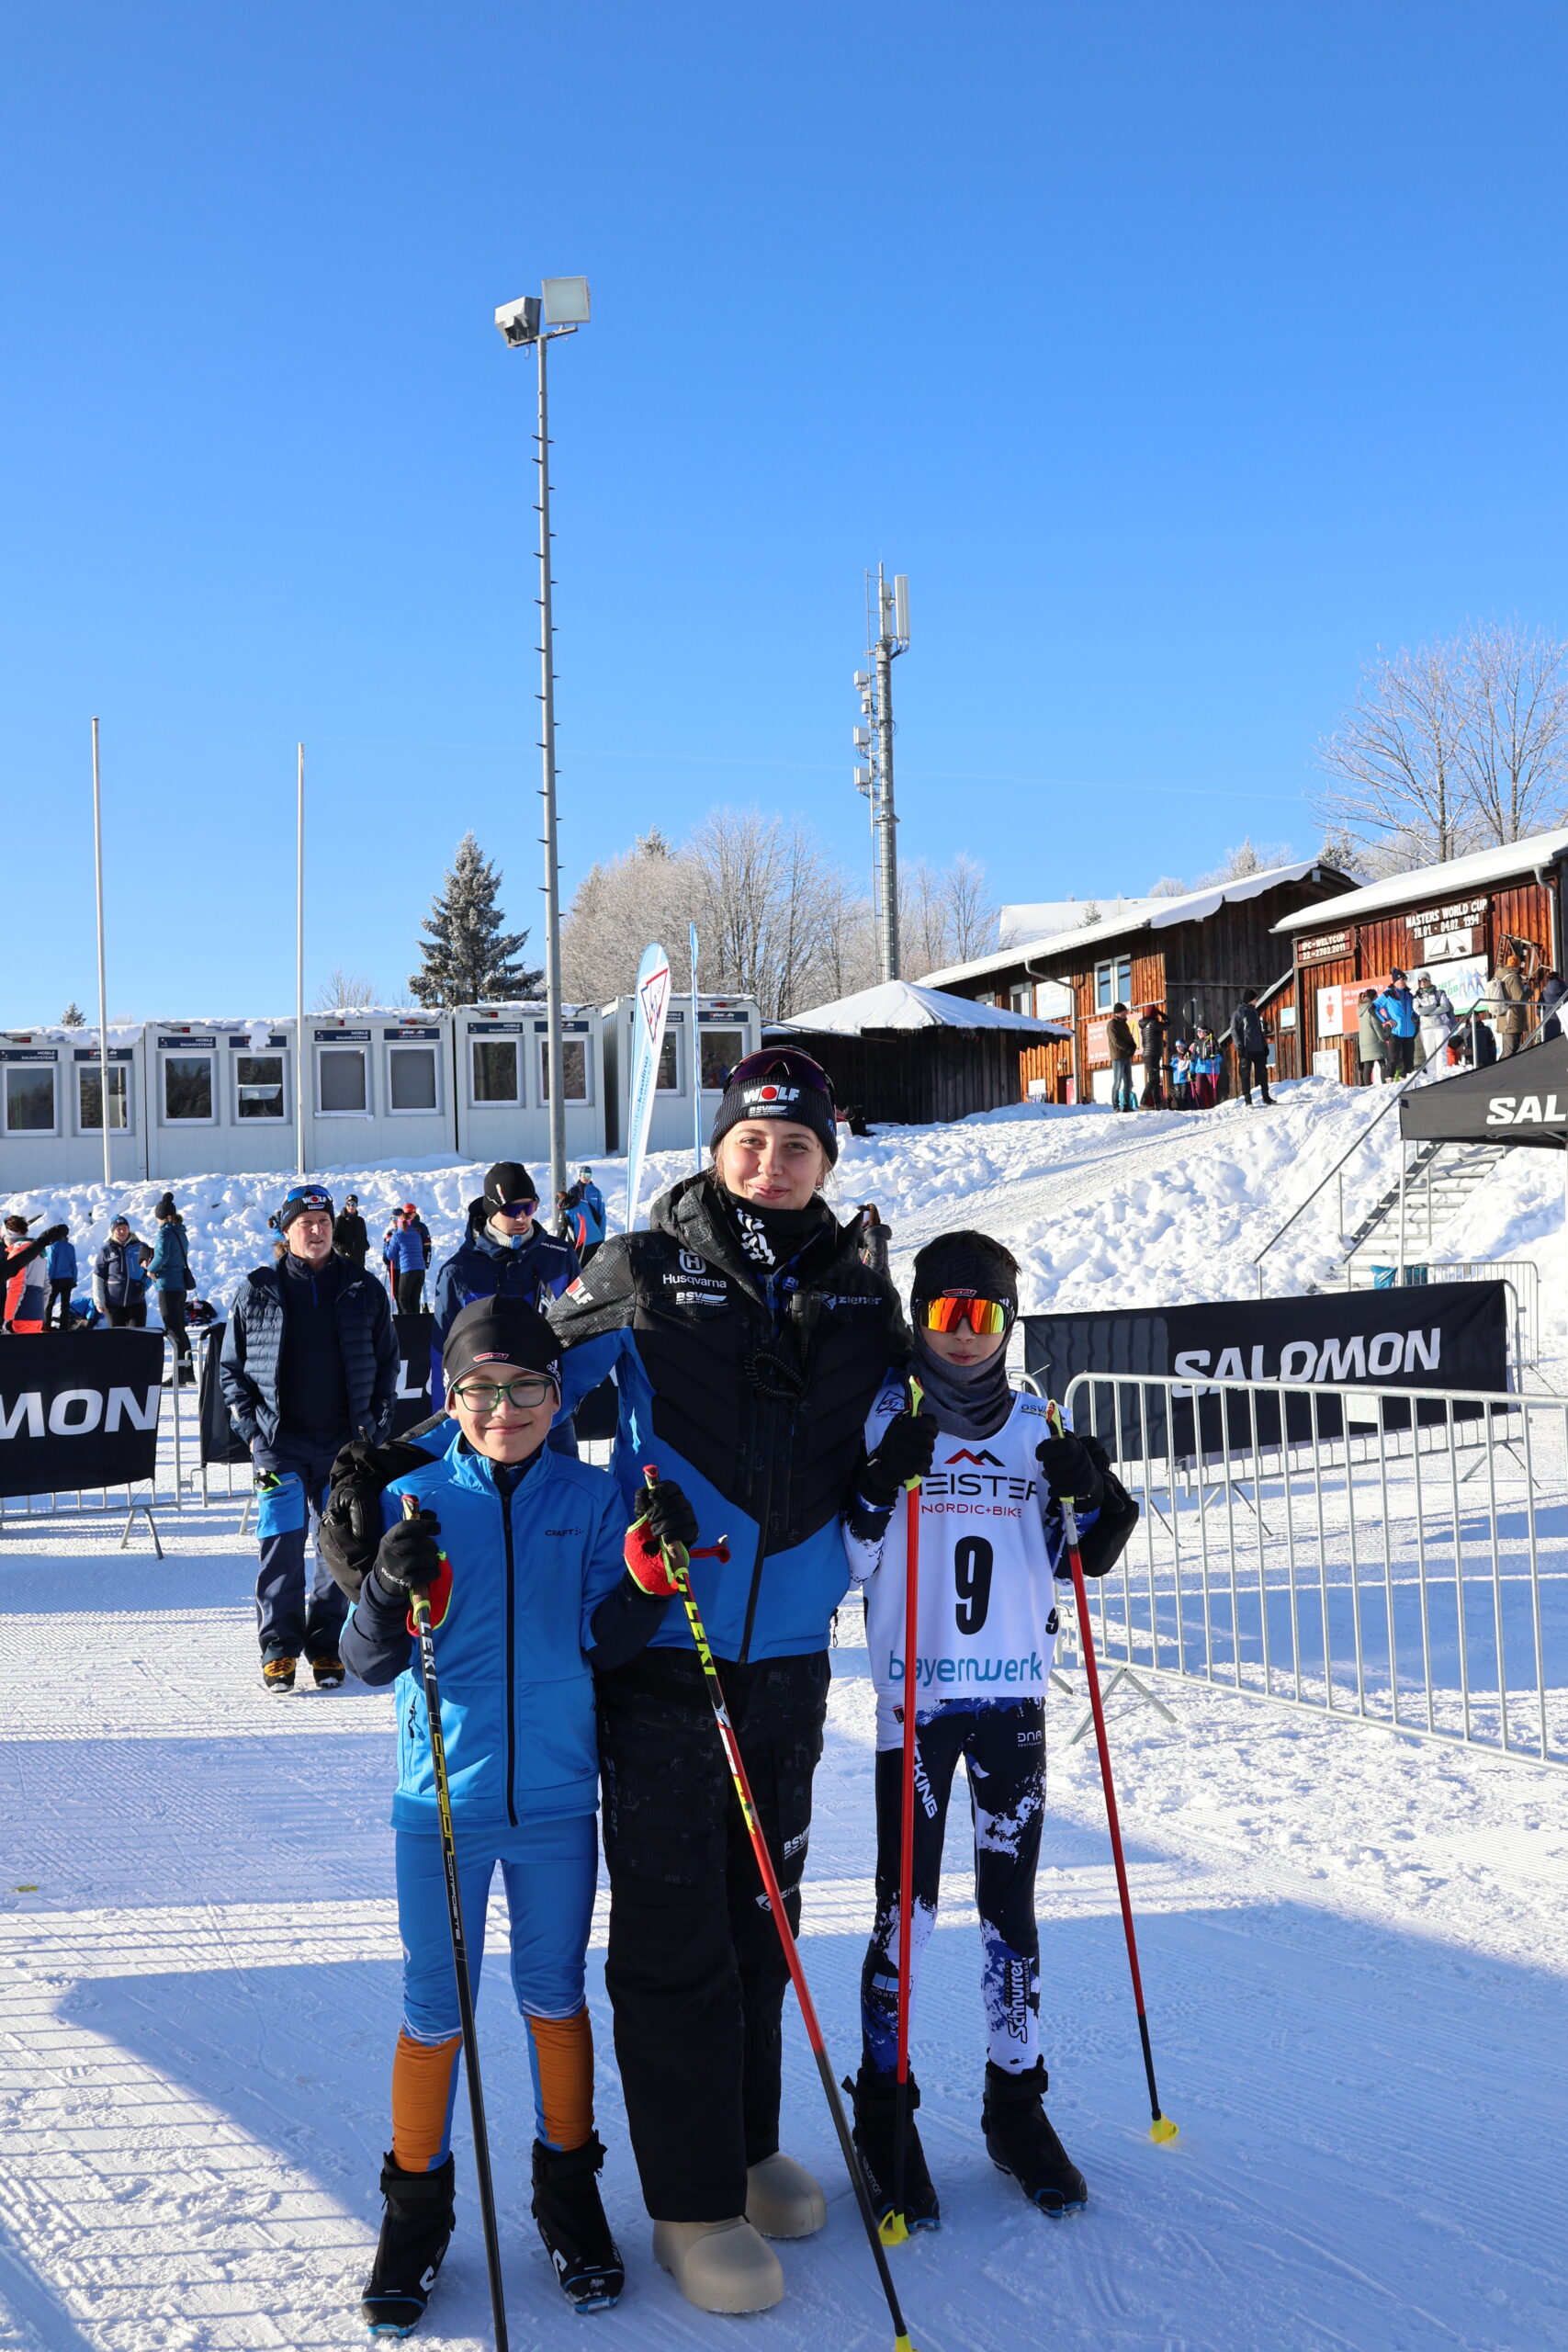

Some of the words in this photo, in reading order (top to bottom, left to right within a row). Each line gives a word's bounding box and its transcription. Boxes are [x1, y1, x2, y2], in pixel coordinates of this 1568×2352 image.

[1405, 910, 1439, 928] MASTERS
[1441, 902, 1469, 920] WORLD
[1471, 898, 1487, 911] CUP
[1463, 912, 1479, 928] 1994
[1302, 933, 1346, 951] IPC-WELTCUP
[743, 1084, 800, 1104] WOLF
[662, 1273, 728, 1288] Husqvarna
[676, 1291, 703, 1302] BSV
[838, 1295, 883, 1306] ziener
[1171, 1328, 1441, 1398] SALOMON
[919, 1473, 1038, 1501] EISTE
[921, 1502, 1022, 1519] NORDIC+BIKE
[545, 1528, 574, 1537] CRAFT
[954, 1535, 994, 1635] 9
[1045, 1607, 1059, 1635] 9
[684, 1601, 717, 1676] LEKI
[420, 1621, 437, 1681] LEKI
[1017, 1730, 1043, 1743] DNA
[446, 1852, 461, 1940] COMPOSITE
[1008, 1959, 1028, 2044] Schnurrer
